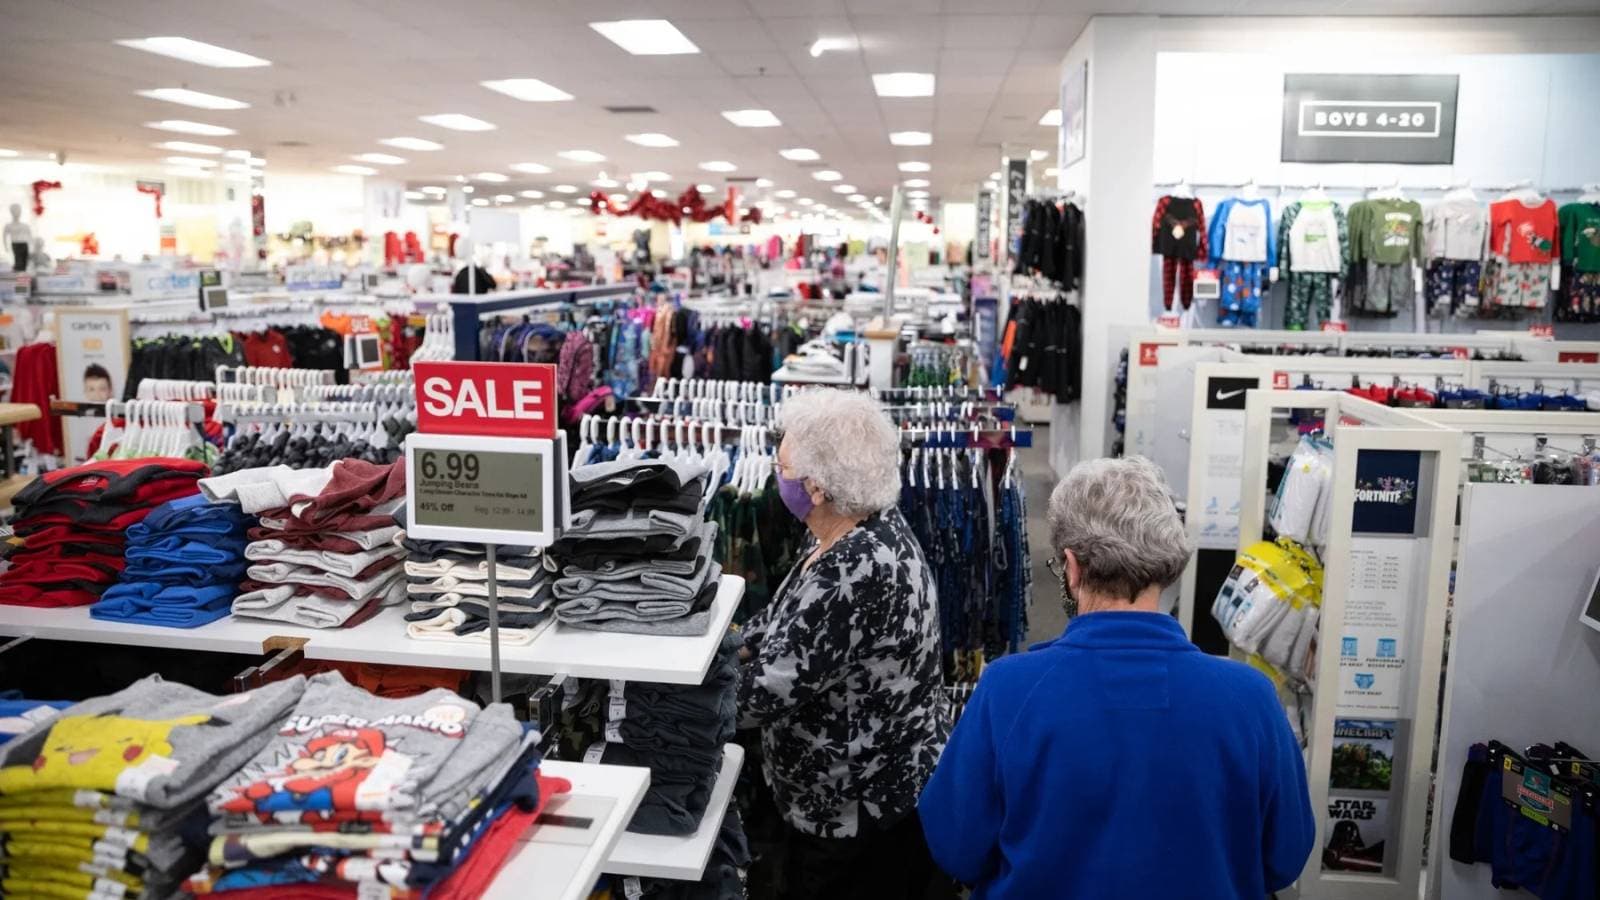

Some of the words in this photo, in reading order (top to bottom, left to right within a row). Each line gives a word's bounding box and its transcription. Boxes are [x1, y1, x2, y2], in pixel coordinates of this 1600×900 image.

[1314, 112, 1368, 127] BOYS
[1375, 112, 1425, 127] 4-20
[71, 320, 111, 331] carter's
[423, 377, 544, 420] SALE
[421, 451, 480, 480] 6.99
[419, 479, 453, 489] Jumping
[455, 481, 479, 489] Beans
[440, 503, 455, 511] Off
[280, 714, 369, 736] SUPER
[1328, 799, 1376, 811] STAR
[1328, 809, 1376, 821] WARS
